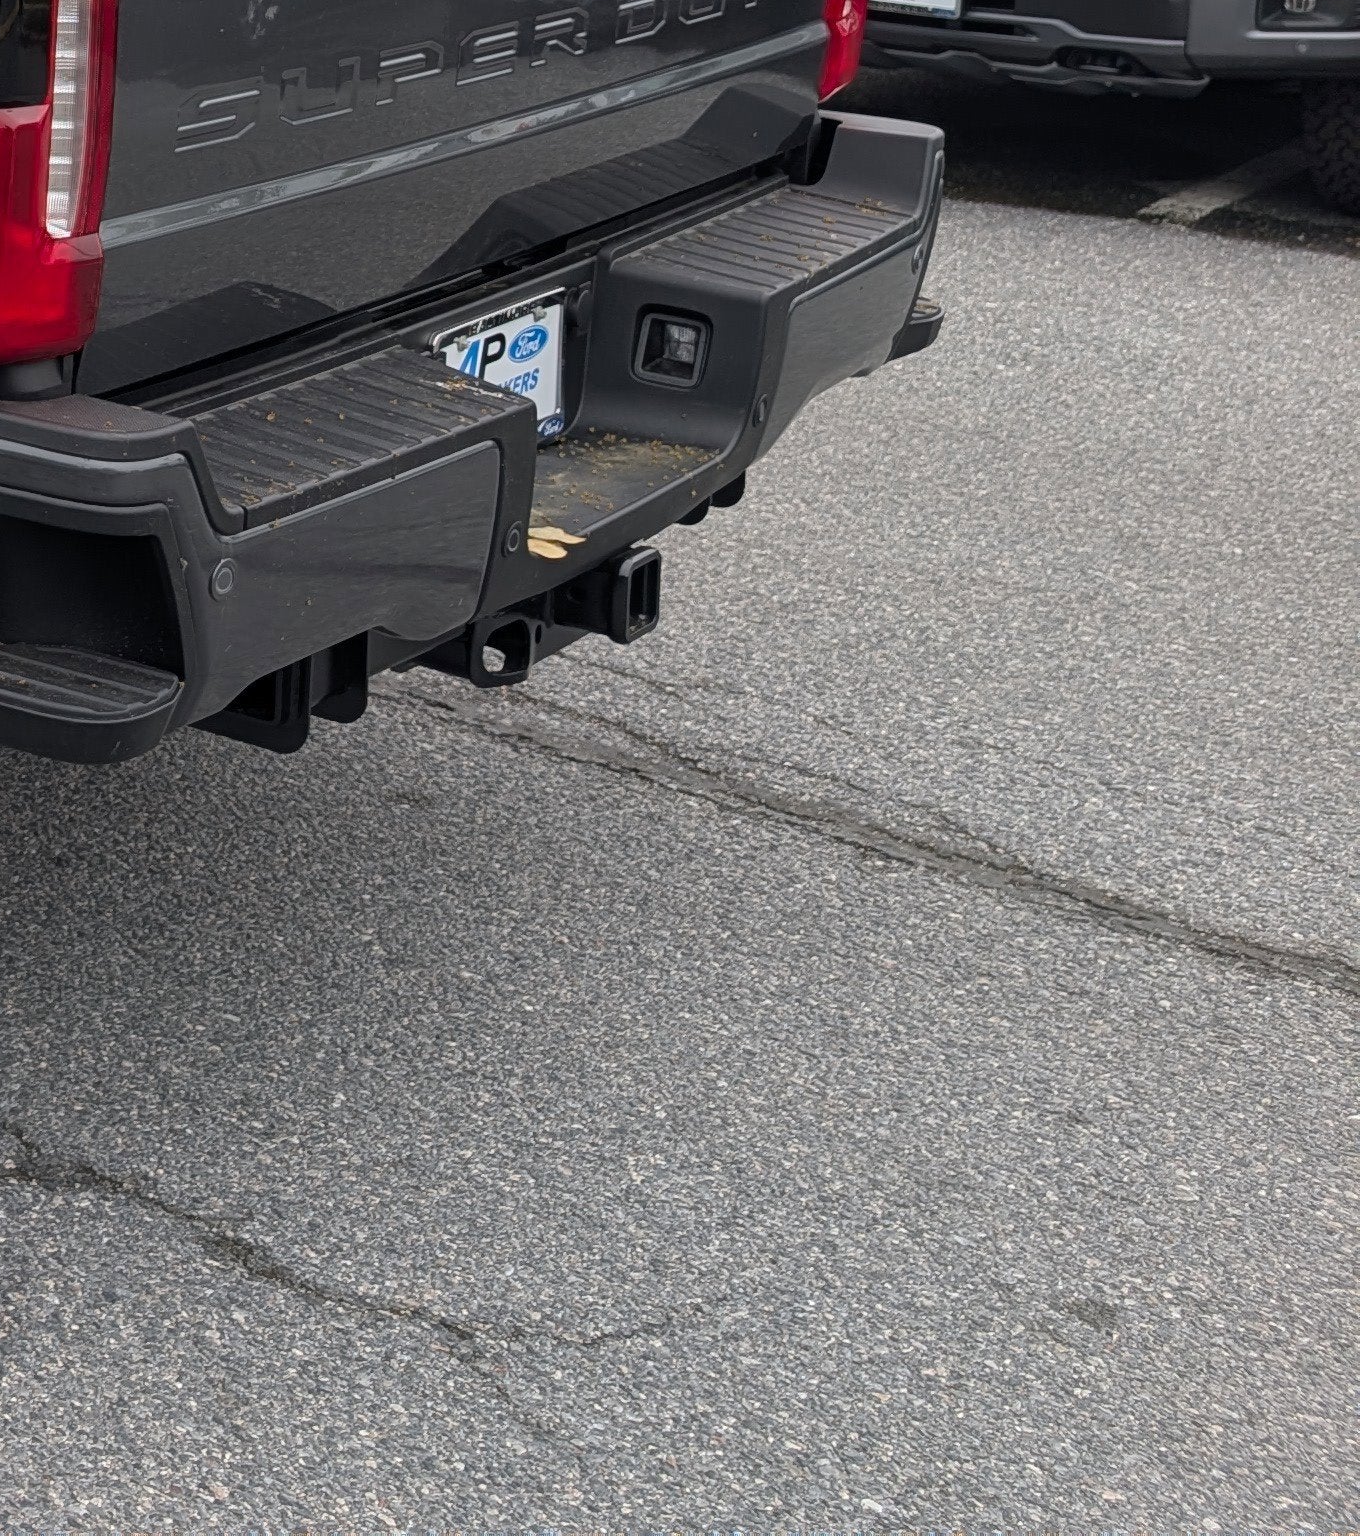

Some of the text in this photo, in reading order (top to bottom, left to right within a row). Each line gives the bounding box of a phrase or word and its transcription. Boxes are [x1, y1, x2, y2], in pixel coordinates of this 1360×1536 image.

[174, 7, 589, 153] SUPER
[512, 328, 545, 360] Ford
[499, 367, 540, 394] KERS
